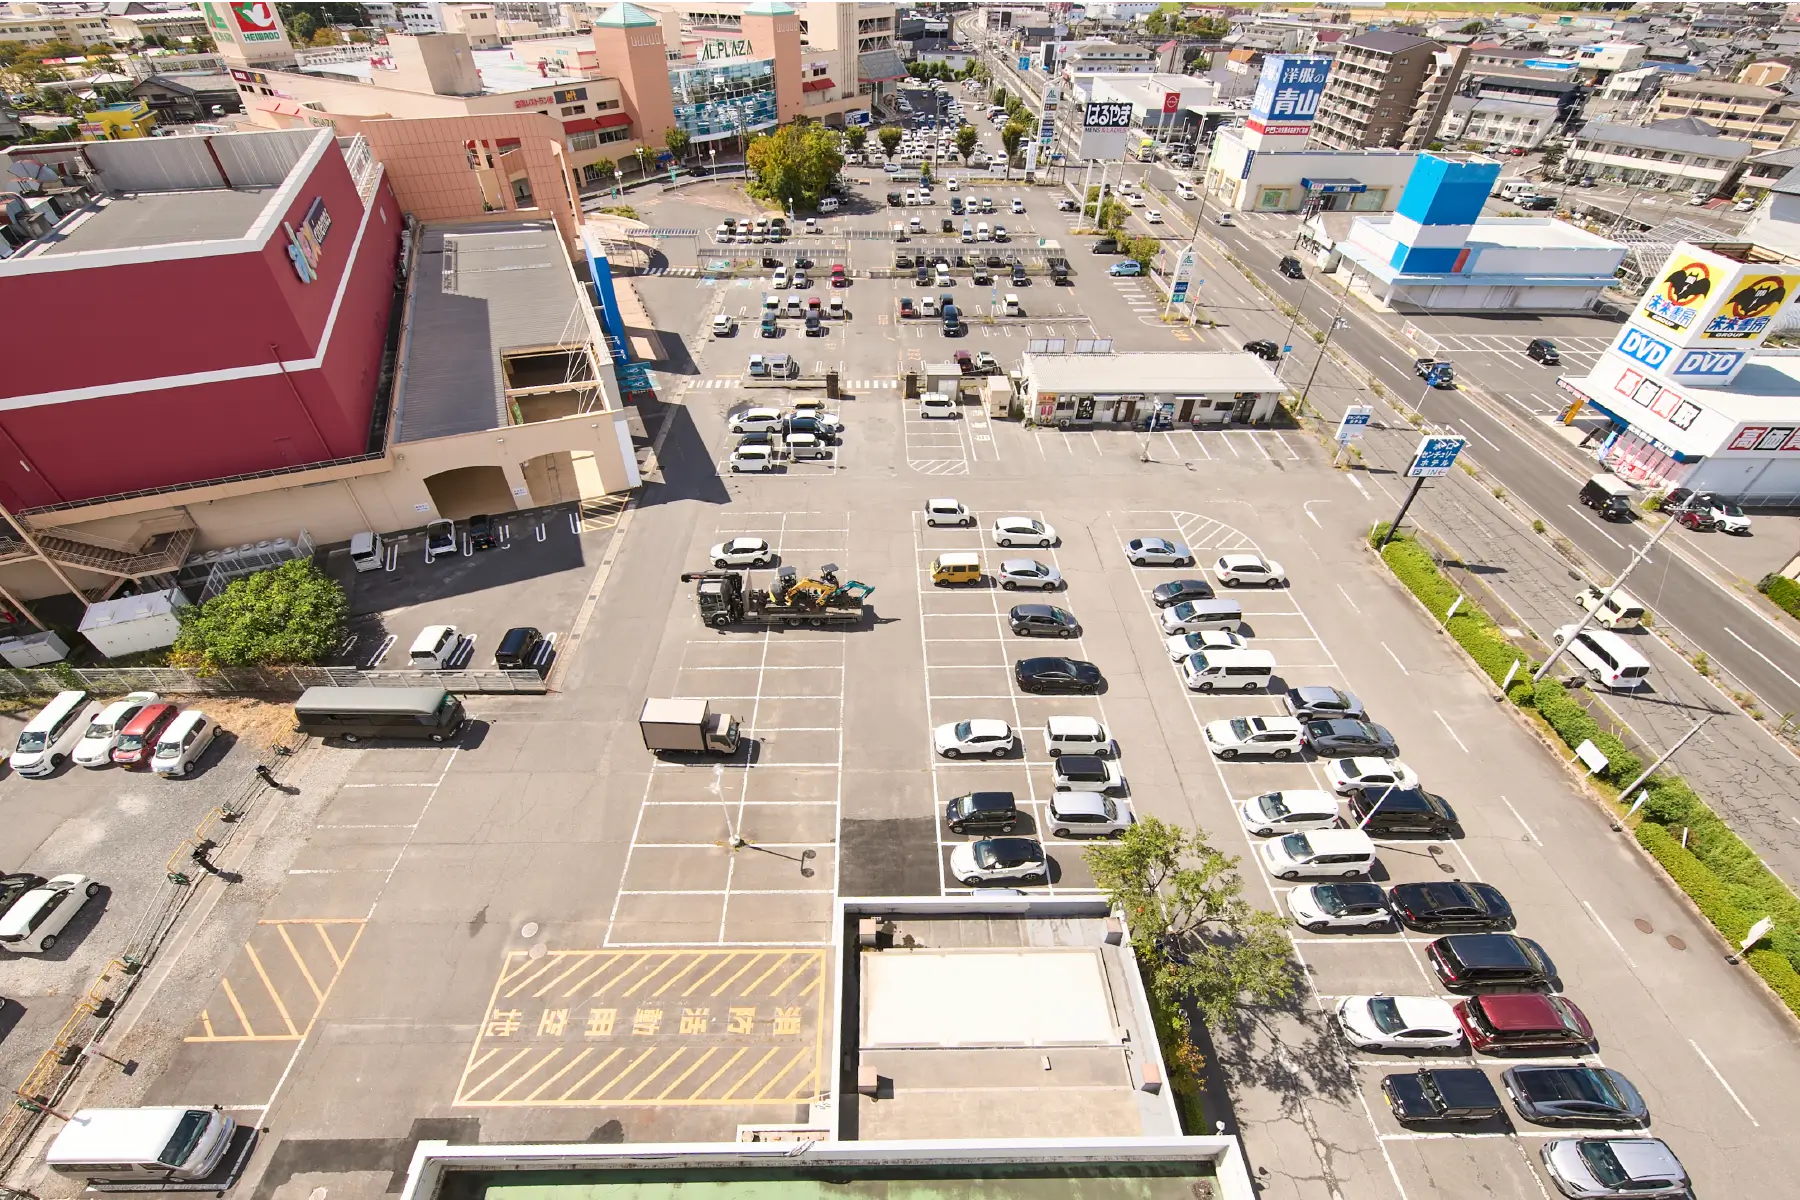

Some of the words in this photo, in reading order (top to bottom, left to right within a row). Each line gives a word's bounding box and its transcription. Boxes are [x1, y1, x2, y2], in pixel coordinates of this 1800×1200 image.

[243, 32, 280, 41] HEIWADO
[1282, 67, 1324, 84] 洋服の
[1273, 87, 1320, 115] 青山
[1085, 104, 1131, 126] はるやま
[1651, 314, 1676, 328] GROUP
[1708, 315, 1771, 332] 未来書房
[1622, 331, 1669, 367] DVD
[1679, 352, 1736, 373] DVD
[1420, 459, 1450, 467] ホテル
[1421, 451, 1457, 459] センチュリー
